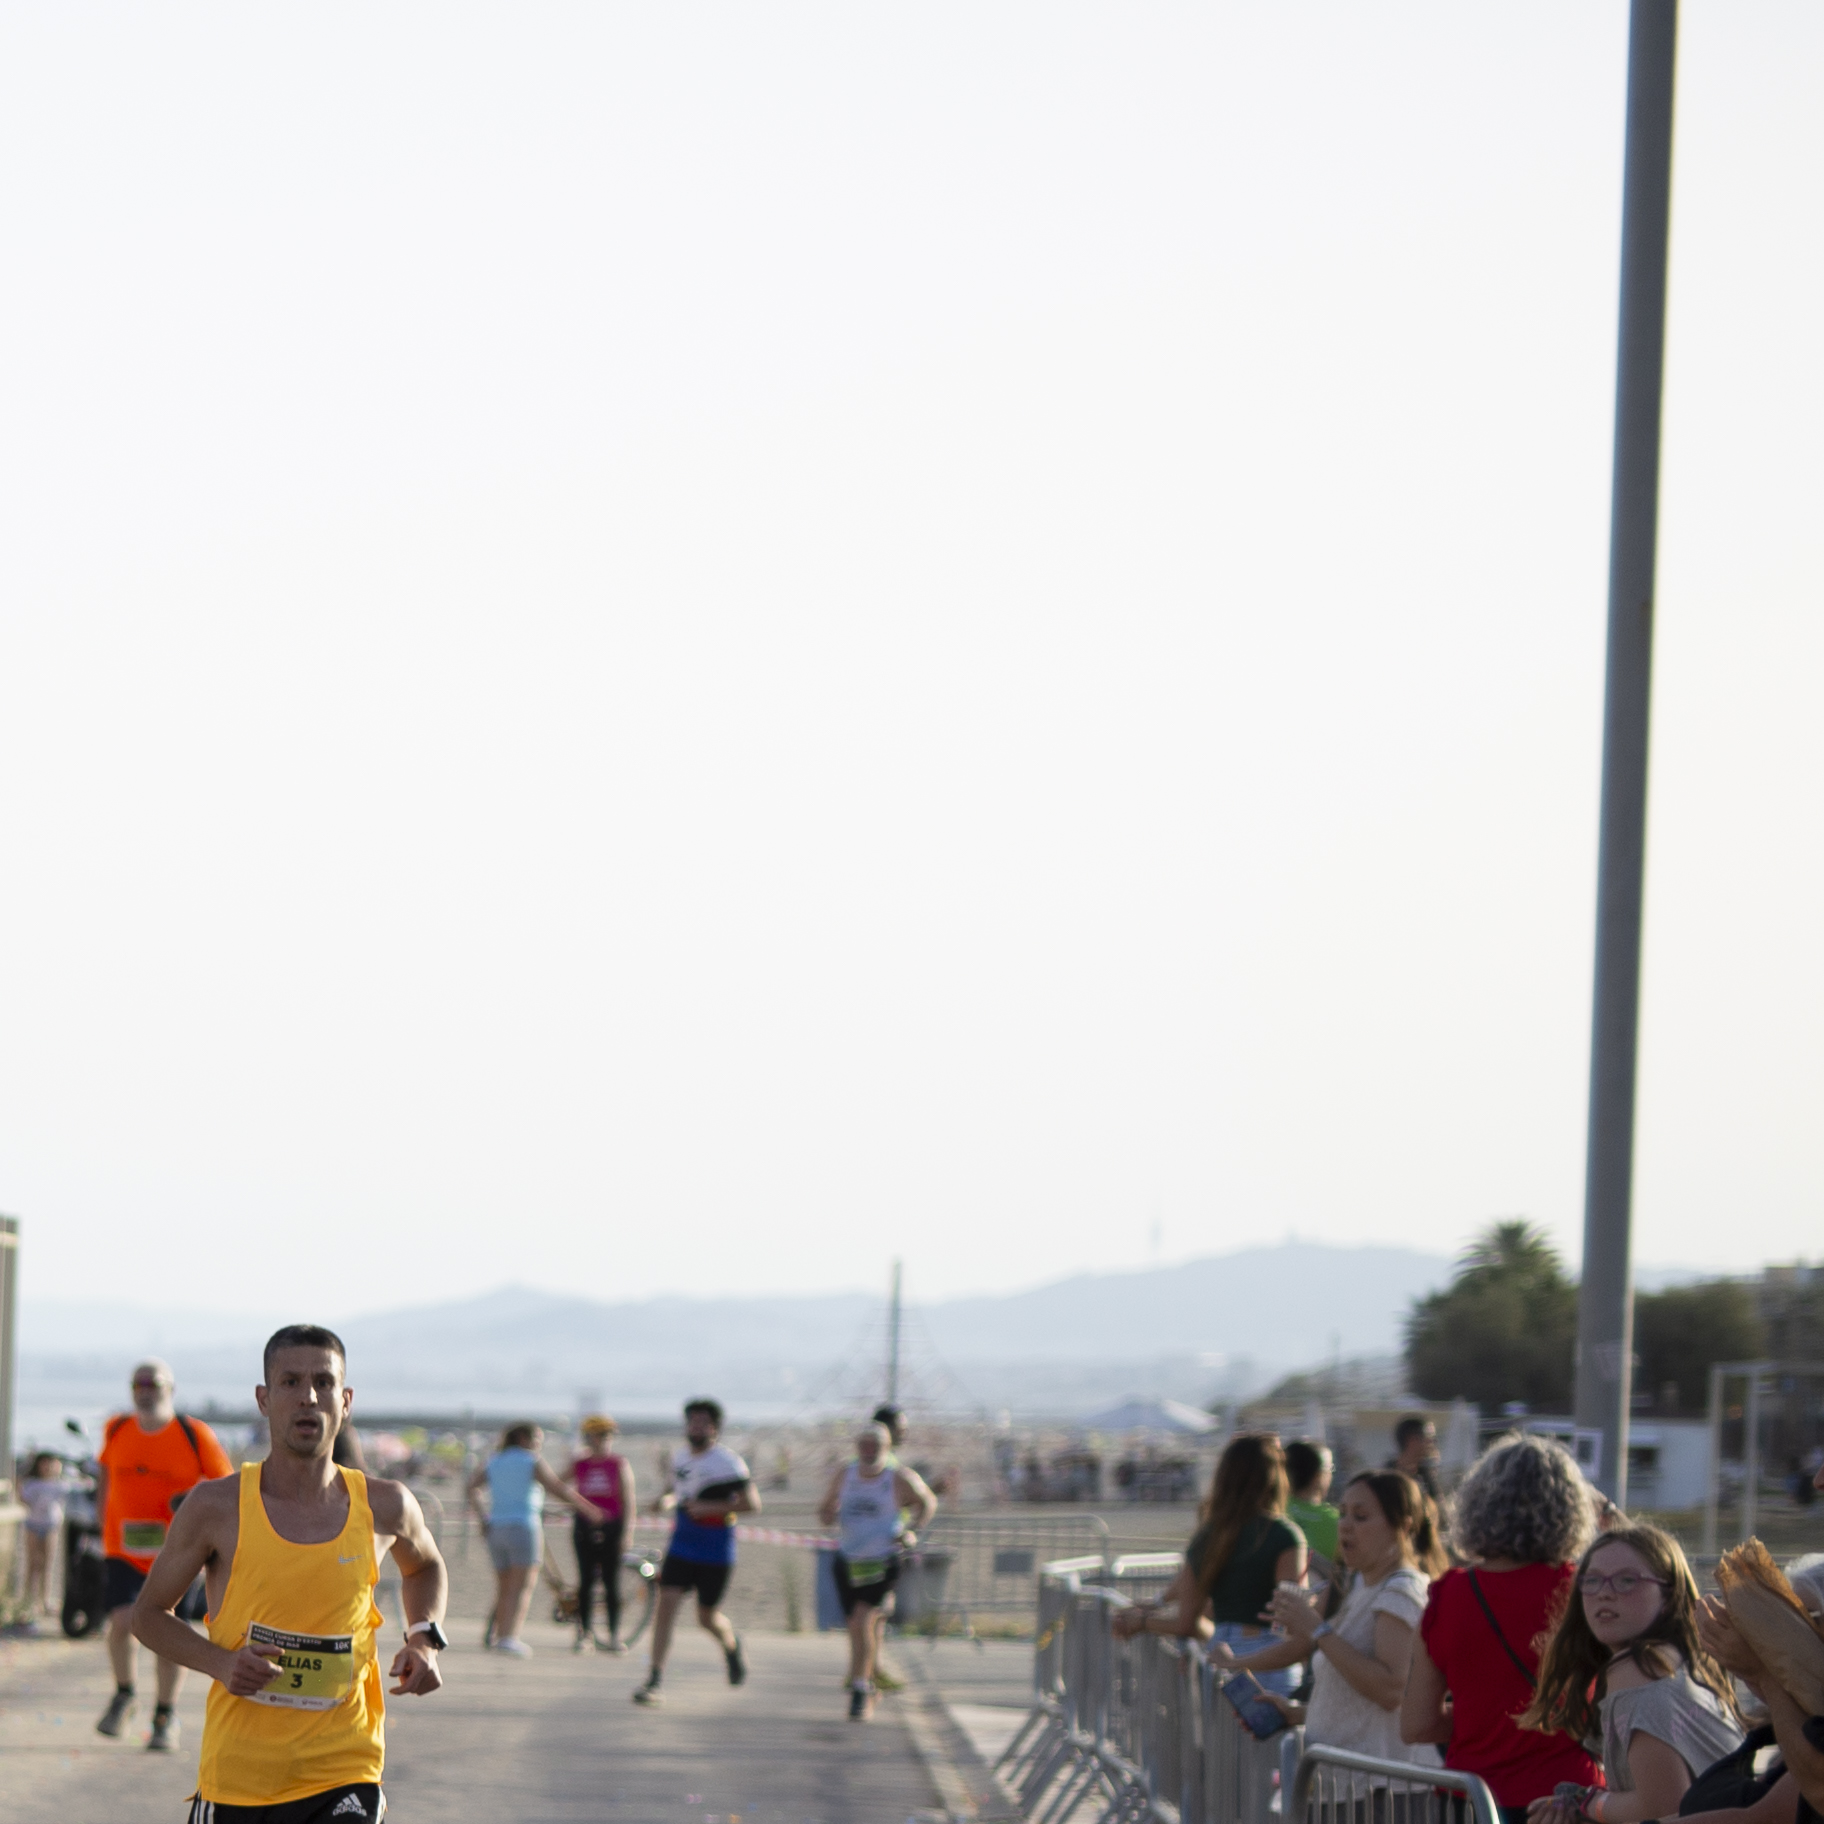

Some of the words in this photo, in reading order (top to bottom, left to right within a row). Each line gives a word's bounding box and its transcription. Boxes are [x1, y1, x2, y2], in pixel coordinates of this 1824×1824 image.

[334, 1641, 350, 1651] 10K
[278, 1655, 323, 1671] ELIAS
[290, 1673, 304, 1689] 3
